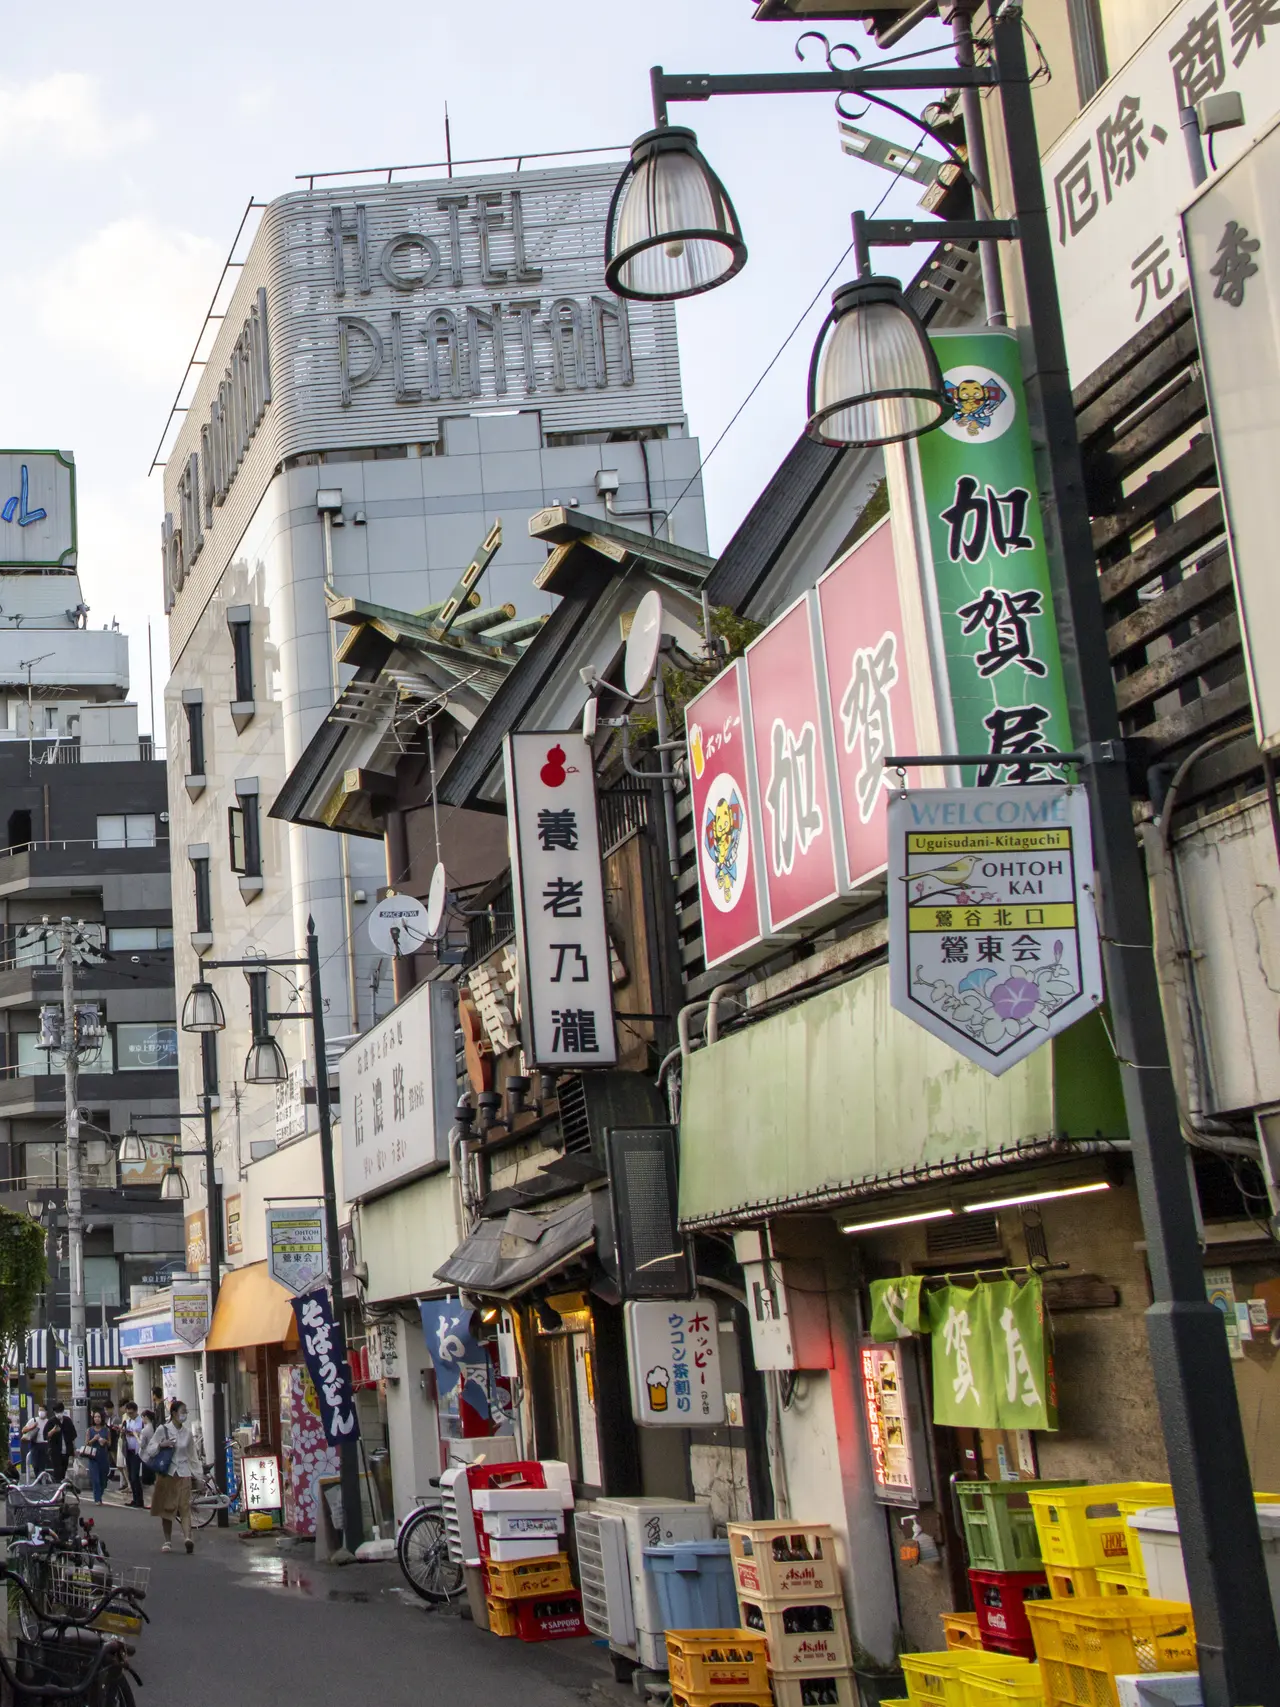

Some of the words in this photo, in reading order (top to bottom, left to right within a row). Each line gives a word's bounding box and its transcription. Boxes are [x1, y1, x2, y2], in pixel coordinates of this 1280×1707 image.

[326, 190, 544, 298] HOTEL
[1130, 234, 1185, 322] 元
[337, 295, 635, 408] PLANTAN
[939, 475, 1067, 786] 加賀屋
[706, 715, 740, 760] ホッピー
[765, 631, 908, 877] 加賀
[911, 799, 1066, 826] WELCOME
[915, 833, 1060, 852] Uguisudani-Kitaguchi
[982, 861, 1063, 878] OHTOH
[1008, 880, 1043, 895] KAI
[537, 808, 599, 1053] 養老乃瀧
[354, 1062, 405, 1148] 信濃路
[302, 1299, 355, 1437] そばうどん
[668, 1313, 691, 1413] ウコン茶割り
[688, 1310, 713, 1385] ホッピー
[267, 1459, 277, 1495] ラーメン
[1105, 1533, 1128, 1549] HOP
[786, 1567, 815, 1580] Asahi
[548, 1618, 580, 1629] SAPPORO
[799, 1640, 828, 1653] Asahi
